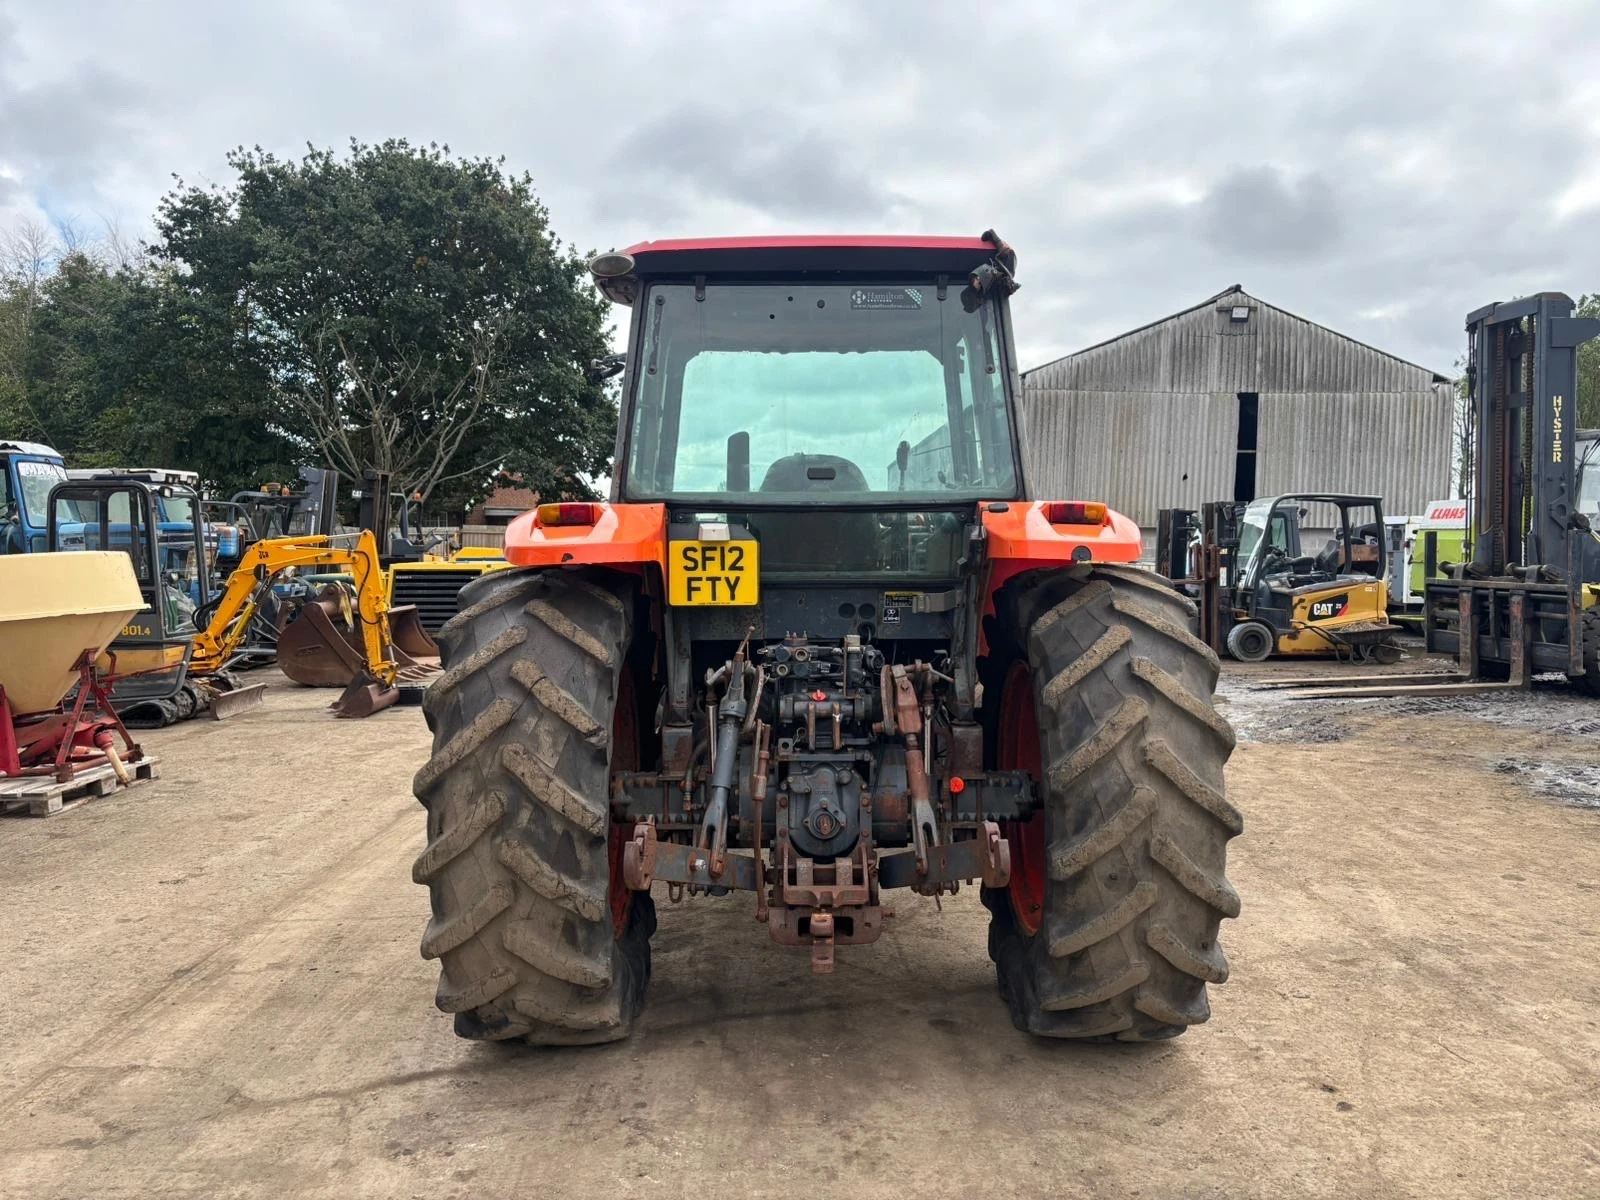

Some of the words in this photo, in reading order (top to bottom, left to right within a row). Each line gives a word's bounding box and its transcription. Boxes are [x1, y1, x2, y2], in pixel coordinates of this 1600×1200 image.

[867, 292, 904, 300] Hamilton
[1553, 395, 1562, 463] HYSTER
[1430, 508, 1466, 520] CLAAS
[682, 546, 744, 571] SF12
[687, 576, 740, 601] FTY
[1313, 603, 1333, 615] CAT
